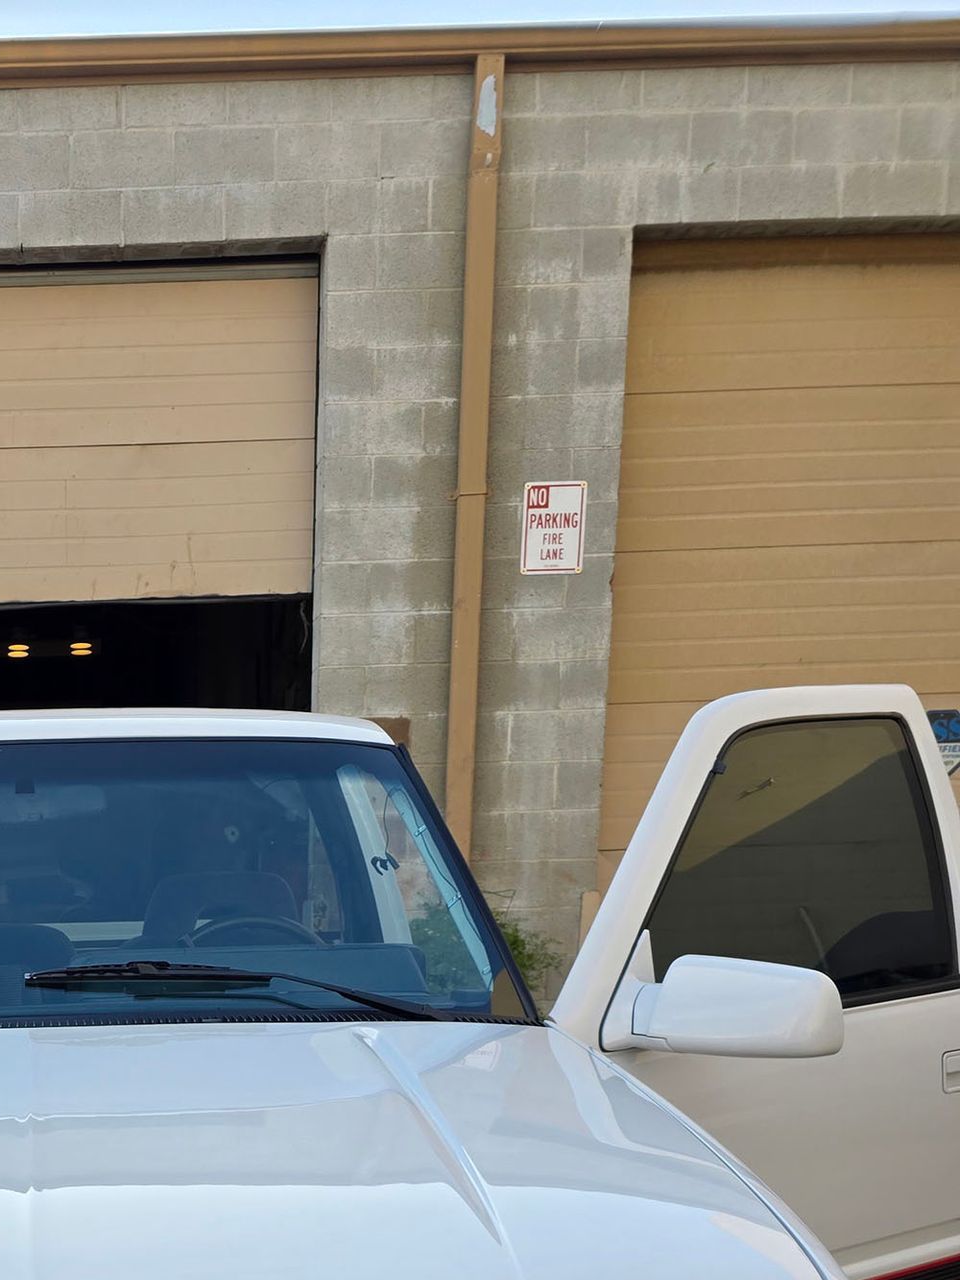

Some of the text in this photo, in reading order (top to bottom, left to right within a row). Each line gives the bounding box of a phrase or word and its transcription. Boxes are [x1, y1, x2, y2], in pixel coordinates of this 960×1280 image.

[529, 488, 547, 506] NO
[529, 513, 578, 529] PARKING
[543, 533, 564, 545] FIRE
[540, 549, 565, 560] LANE
